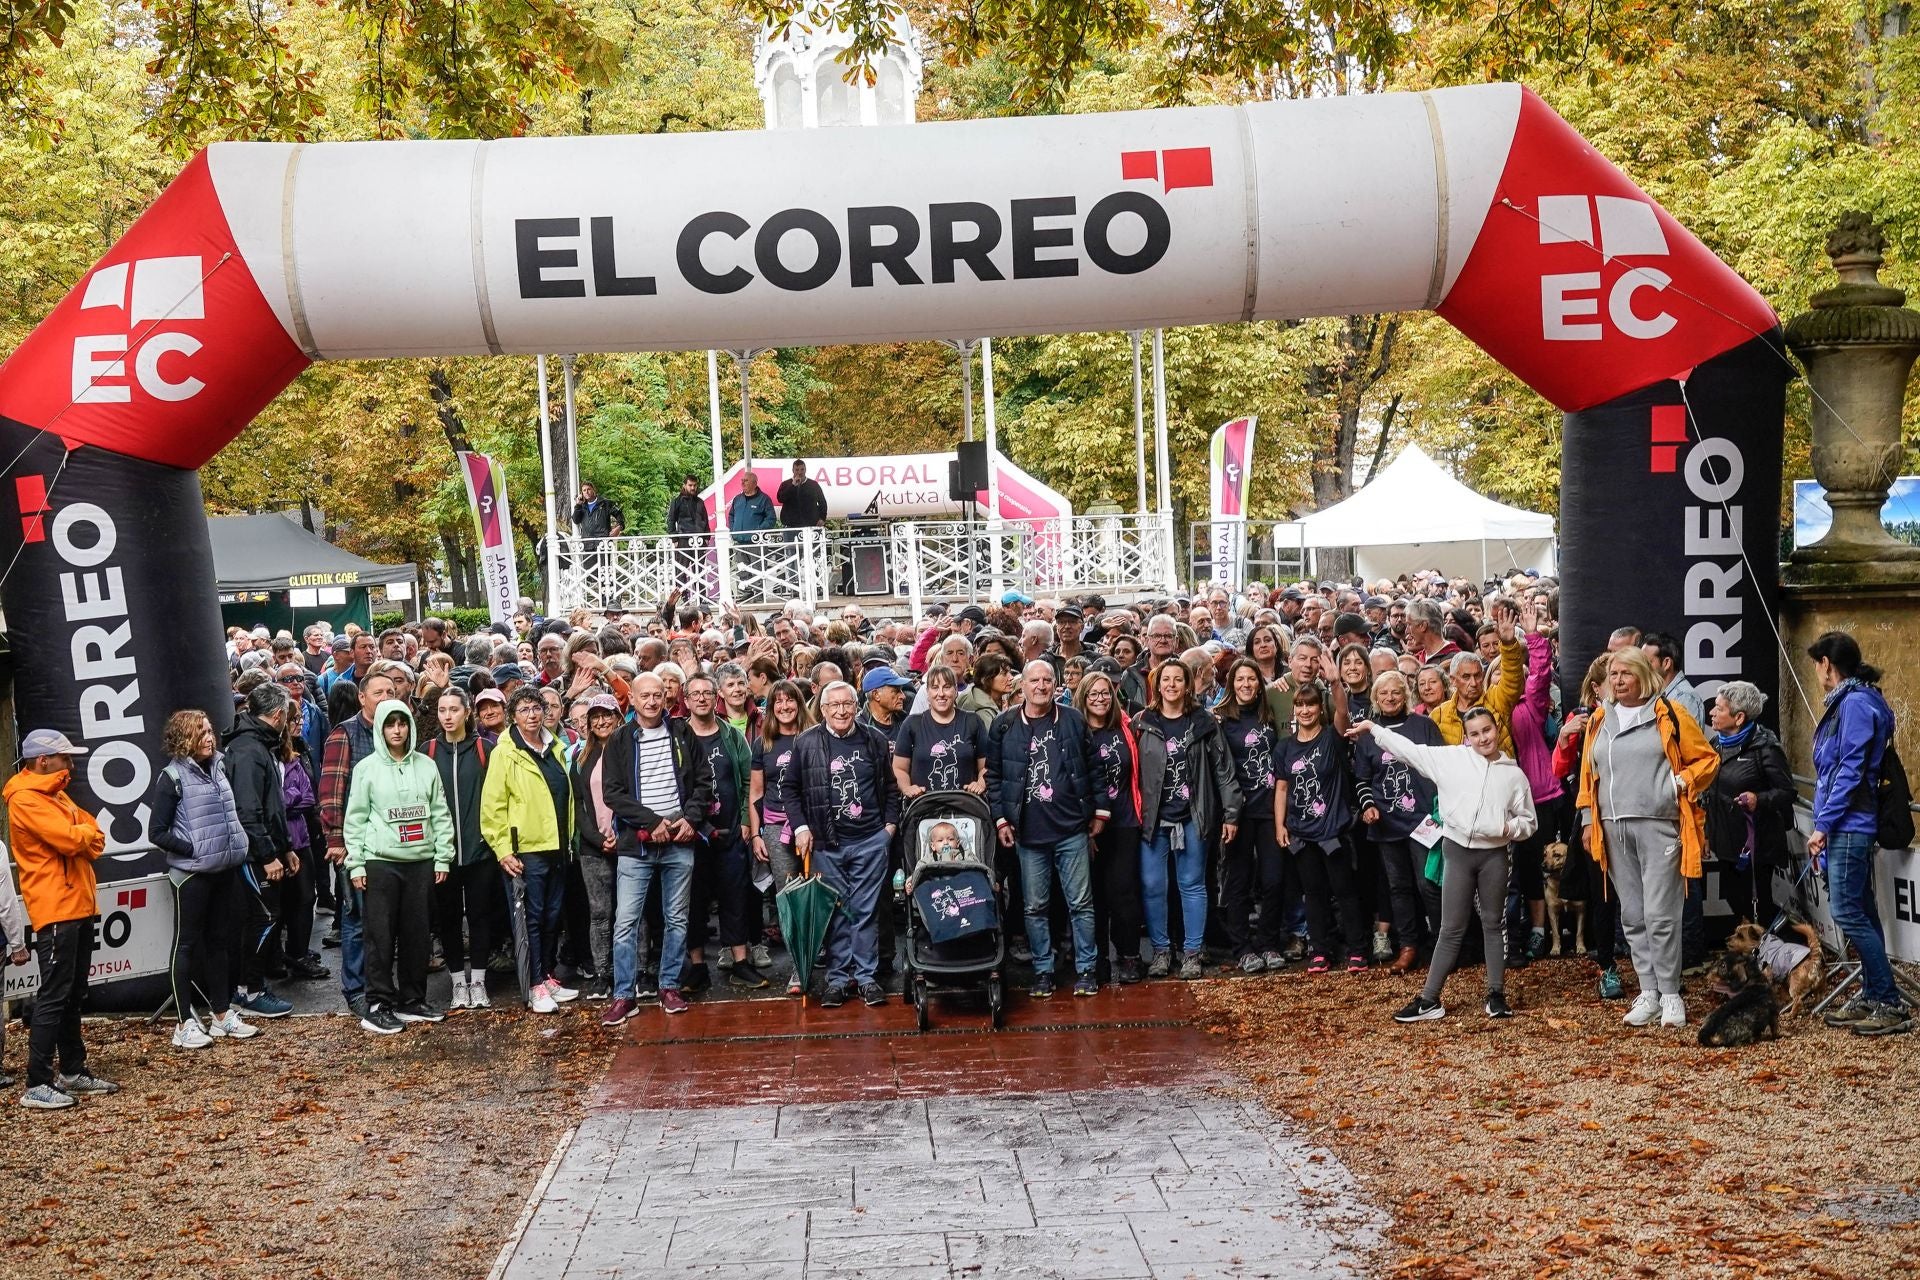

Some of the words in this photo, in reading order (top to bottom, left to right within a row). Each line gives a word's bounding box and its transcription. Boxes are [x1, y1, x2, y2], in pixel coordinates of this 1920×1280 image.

[515, 217, 657, 299] EL
[676, 191, 1171, 295] CORREO
[1541, 267, 1678, 341] EC
[71, 332, 206, 404] EC
[814, 463, 938, 487] ABORAL
[880, 490, 939, 505] kutxa
[336, 571, 359, 585] GABE
[1683, 437, 1745, 743] RREO
[52, 502, 153, 862] CORREO
[6, 974, 39, 992] MAZI
[89, 959, 132, 977] OTSUA
